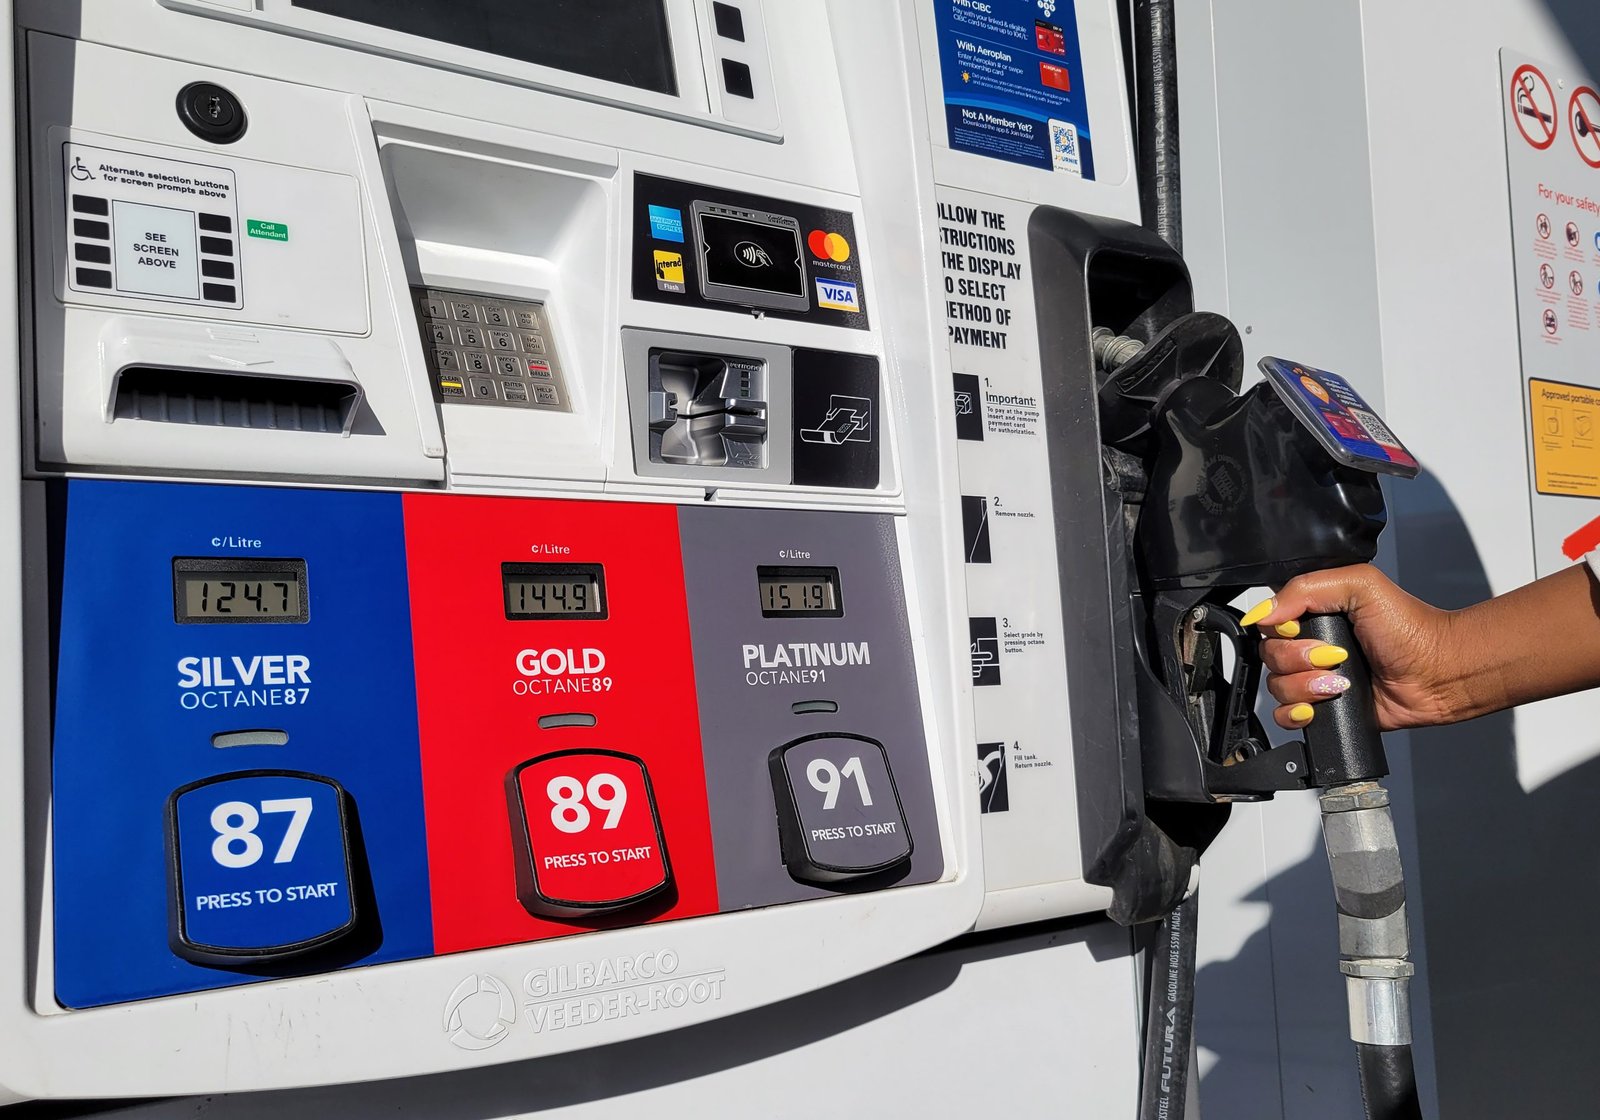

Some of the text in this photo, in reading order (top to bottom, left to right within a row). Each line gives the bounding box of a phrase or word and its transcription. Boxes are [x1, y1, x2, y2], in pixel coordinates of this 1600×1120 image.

[964, 10, 975, 18] with
[972, 1, 992, 14] CIBC
[1150, 6, 1160, 18] USA
[968, 18, 980, 26] card
[987, 24, 998, 32] save
[1152, 29, 1162, 46] MADE
[956, 40, 1012, 62] With Aeroplan
[958, 51, 972, 60] Enter
[973, 56, 996, 68] Aeroplan
[1008, 66, 1024, 74] swipe
[958, 60, 991, 73] membership
[1153, 63, 1163, 82] HOSE
[1154, 82, 1164, 113] GASOLINE
[962, 108, 1032, 132] Not A Member Yet?
[962, 118, 987, 128] Download
[996, 126, 1005, 134] app
[1155, 117, 1166, 198] FUTURA
[99, 164, 230, 190] Alternate selection buttons
[104, 174, 226, 198] for screen prompts above
[1538, 184, 1600, 217] For your safety
[981, 210, 1006, 230] THE
[145, 232, 166, 242] SEE
[250, 228, 286, 239] Attendant
[939, 227, 1015, 256] TRUCTIONS
[133, 244, 179, 256] SCREEN
[138, 257, 176, 269] ABOVE
[813, 260, 850, 270] mastercard
[942, 252, 1021, 280] THE DISPLAY
[822, 286, 854, 303] VISA
[958, 278, 1006, 302] SELECT
[430, 306, 438, 314] 1
[462, 310, 470, 318] 2
[492, 314, 500, 322] 3
[996, 308, 1011, 326] OF
[436, 332, 444, 340] 4
[468, 334, 476, 344] 5
[500, 338, 507, 347] 6
[441, 357, 448, 366] 7
[474, 360, 482, 369] 8
[506, 364, 514, 372] 9
[480, 386, 488, 396] 0
[984, 378, 992, 388] 1.
[986, 391, 1036, 406] Important:
[1542, 388, 1570, 401] Approved
[994, 496, 1002, 506] 2.
[202, 582, 288, 612] 124.7
[520, 584, 586, 610] 144.9
[770, 585, 823, 608] 151.9
[1002, 618, 1012, 628] 3.
[516, 648, 606, 676] GOLD
[742, 642, 870, 668] PLATINUM
[178, 655, 312, 688] SILVER
[1014, 740, 1022, 750] 4.
[806, 757, 873, 810] 91
[546, 772, 628, 834] 89
[210, 798, 313, 868] 87
[812, 822, 896, 842] PRESS TO START
[544, 846, 652, 870] PRESS TO START
[196, 882, 338, 910] PRESS TO START
[1172, 912, 1181, 930] MADE
[1170, 950, 1179, 968] HOSE
[522, 948, 679, 998] GILBARCO
[1168, 969, 1178, 1002] GASOLINE
[524, 974, 726, 1034] VEEDER-ROOT
[1160, 1006, 1176, 1092] FUTURA
